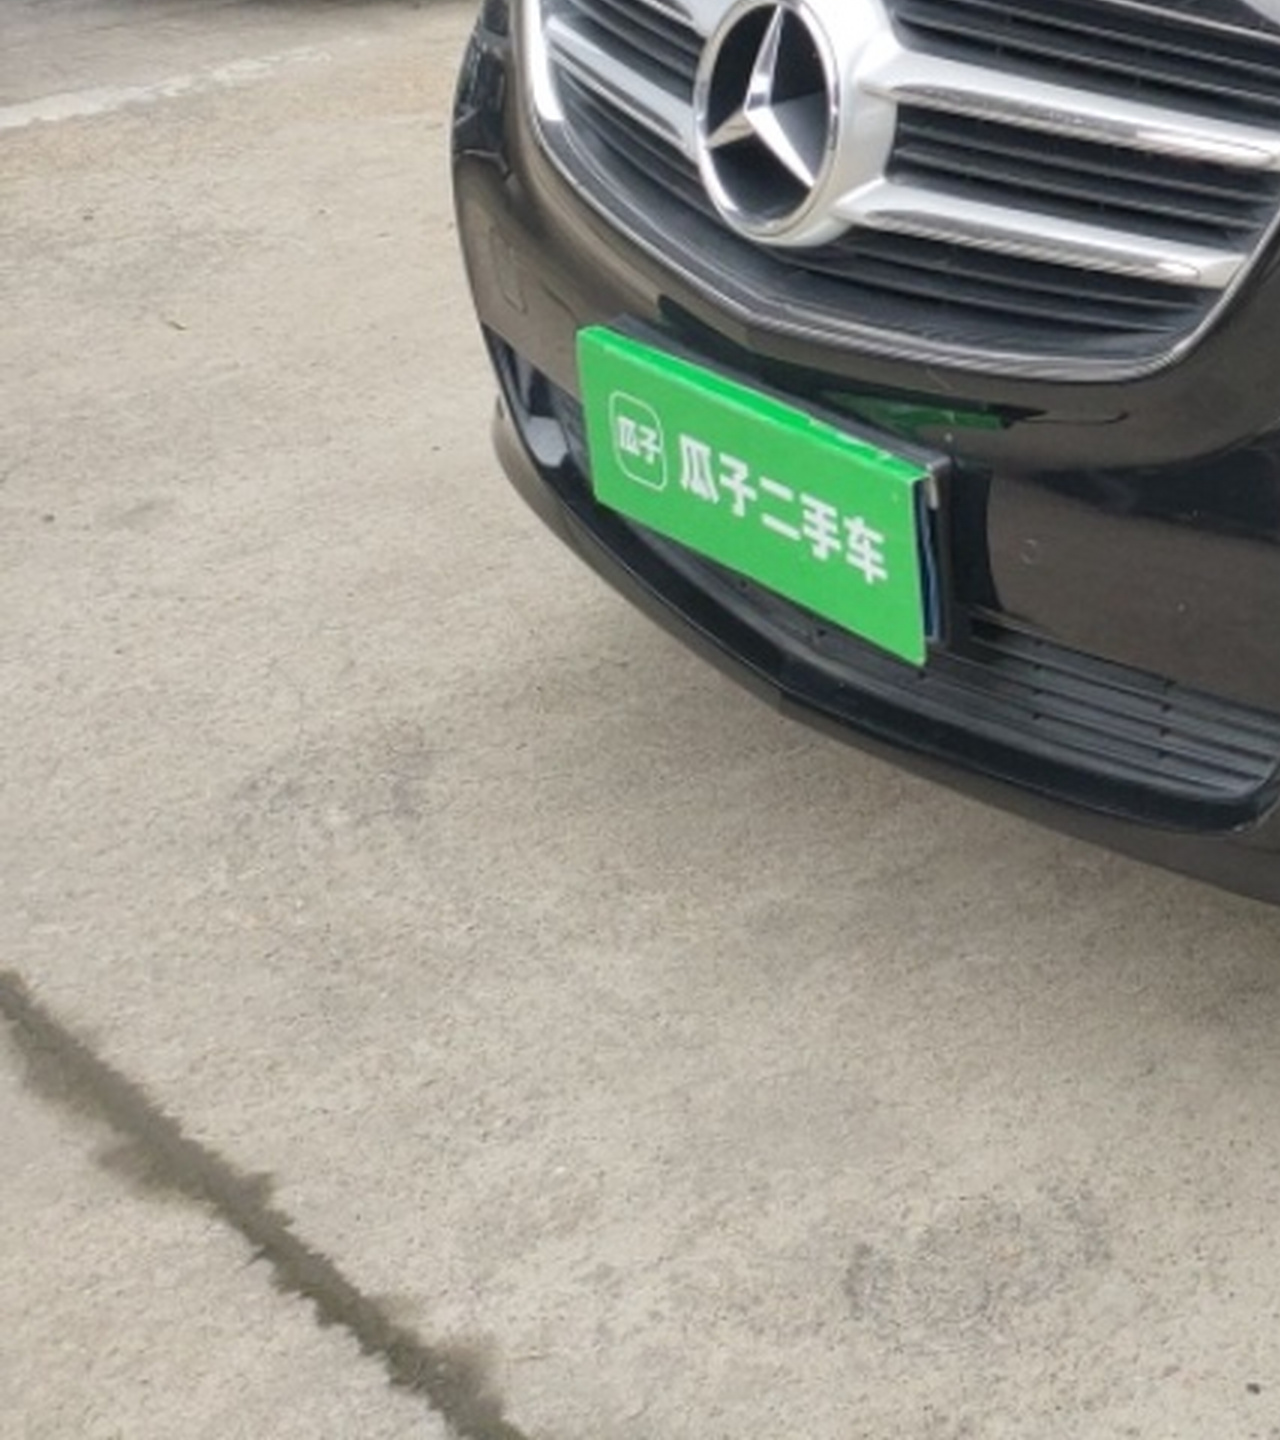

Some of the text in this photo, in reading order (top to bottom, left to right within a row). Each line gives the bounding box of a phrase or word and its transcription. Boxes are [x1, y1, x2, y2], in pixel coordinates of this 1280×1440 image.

[617, 417, 887, 584] 瓜子 瓜子二手车
